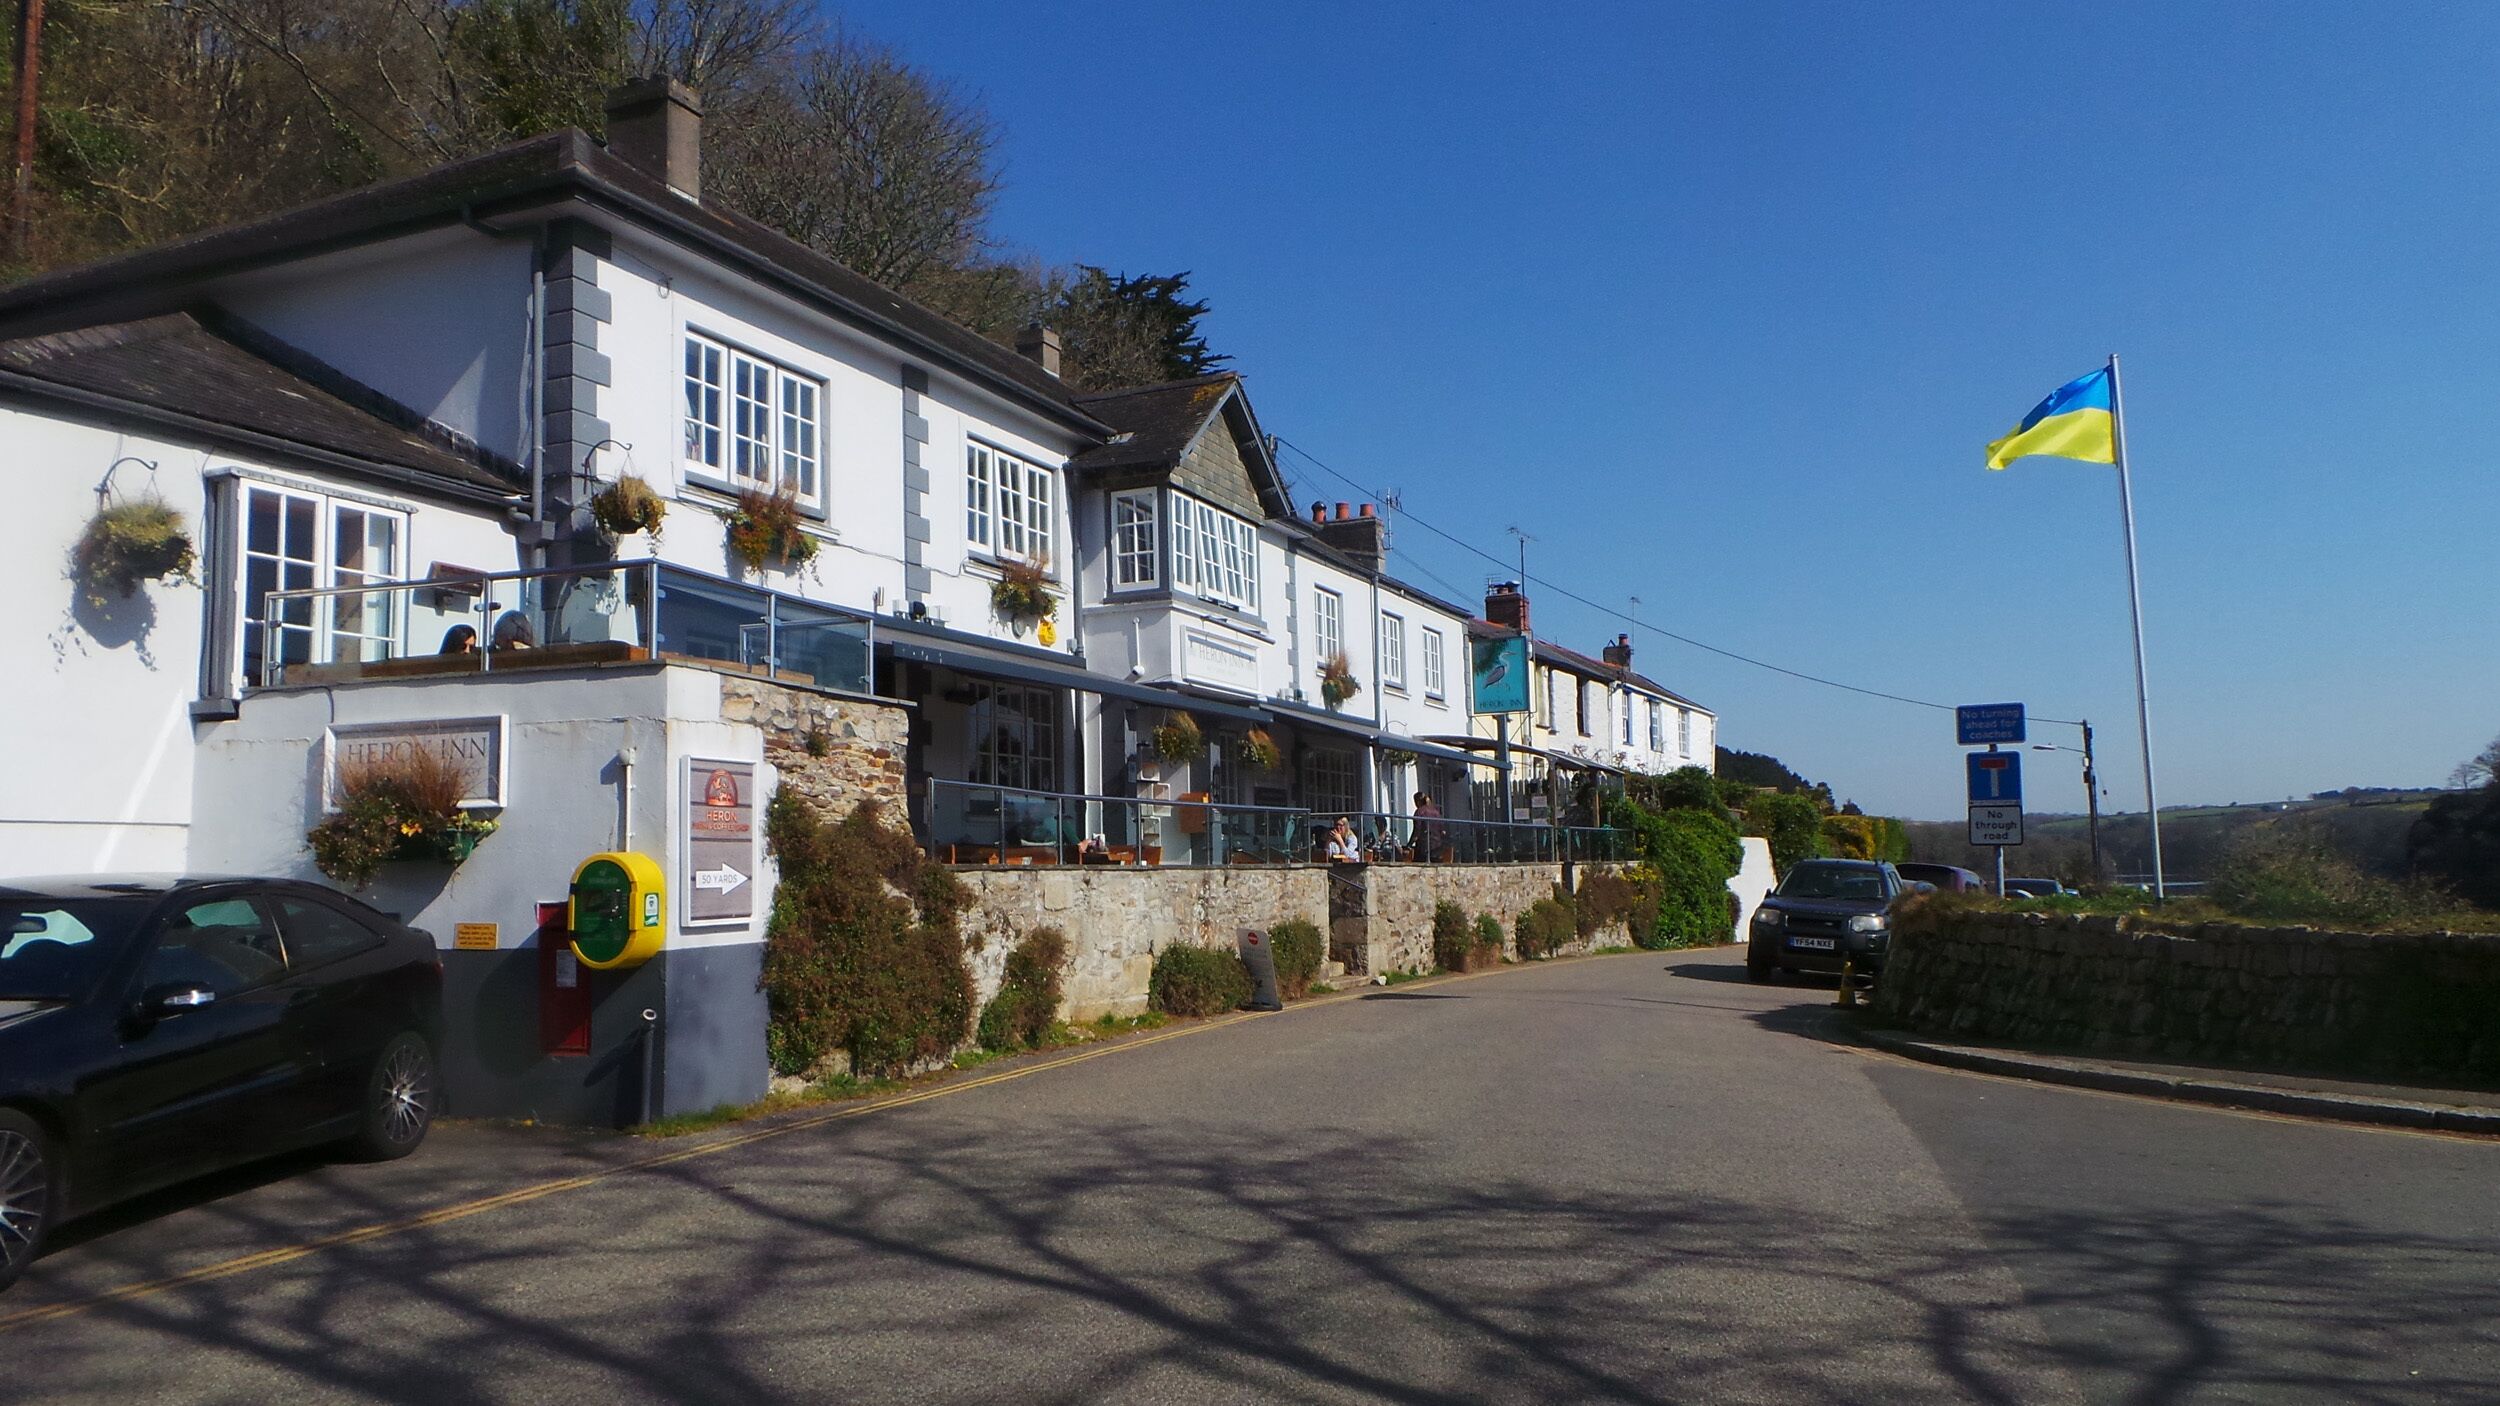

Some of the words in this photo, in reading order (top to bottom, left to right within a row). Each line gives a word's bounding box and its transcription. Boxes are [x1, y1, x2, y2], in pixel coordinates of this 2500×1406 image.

[1962, 711, 1978, 719] No
[1981, 709, 2019, 719] turning
[1966, 720, 1998, 730] ahead
[2001, 718, 2017, 729] for
[1969, 730, 2013, 740] coaches
[441, 737, 487, 760] INN
[706, 810, 737, 822] HERON
[1987, 810, 2003, 819] No
[1975, 820, 2018, 831] through
[1984, 832, 2009, 840] road
[702, 874, 711, 884] 50
[713, 873, 738, 884] YARDS
